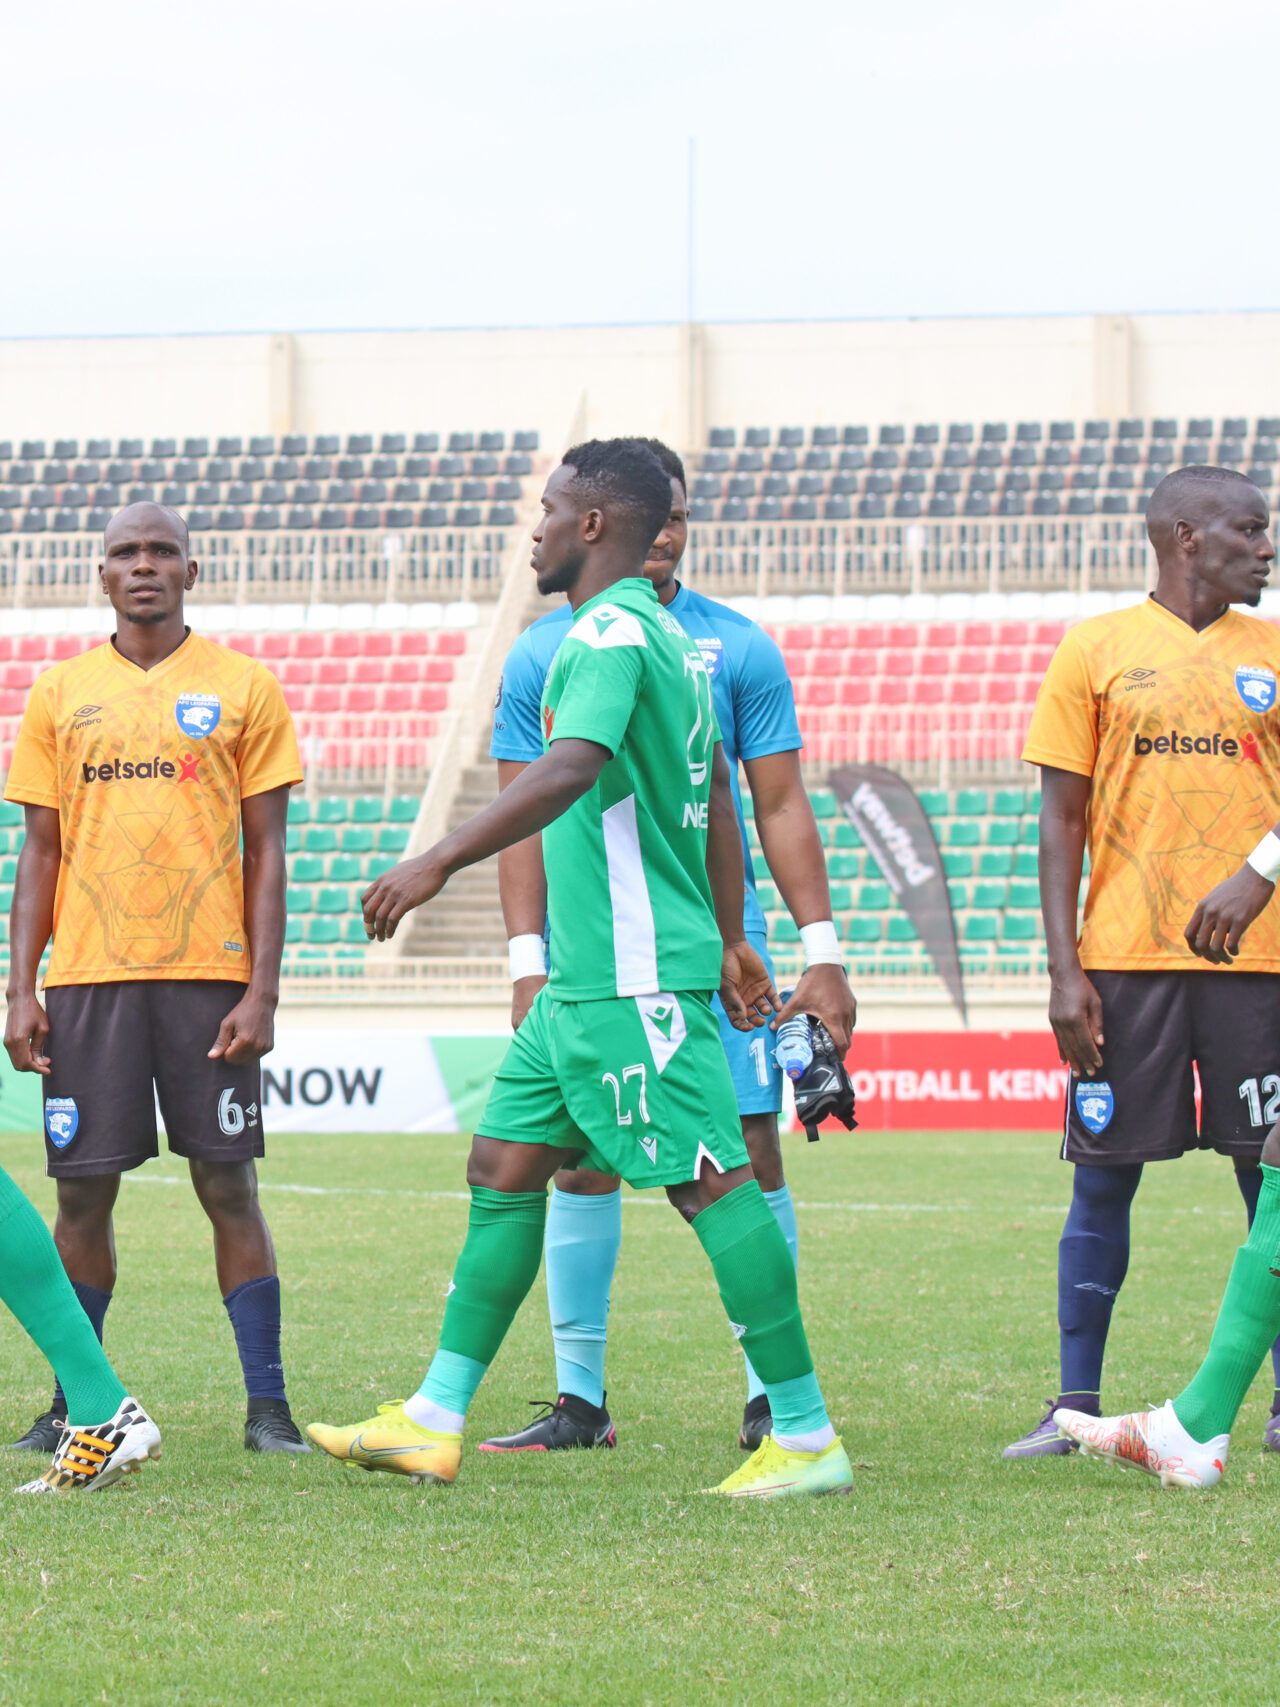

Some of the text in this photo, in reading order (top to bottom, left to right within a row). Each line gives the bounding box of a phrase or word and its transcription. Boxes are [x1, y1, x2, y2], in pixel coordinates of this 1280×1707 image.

[1124, 681, 1156, 692] umbro
[75, 718, 102, 730] umbro
[1134, 730, 1239, 757] betsafe
[82, 756, 176, 784] betsafe
[749, 1037, 769, 1086] 1
[262, 1067, 383, 1106] NOW
[601, 1062, 651, 1126] 27
[1238, 1074, 1280, 1127] 12
[217, 1087, 246, 1136] 6
